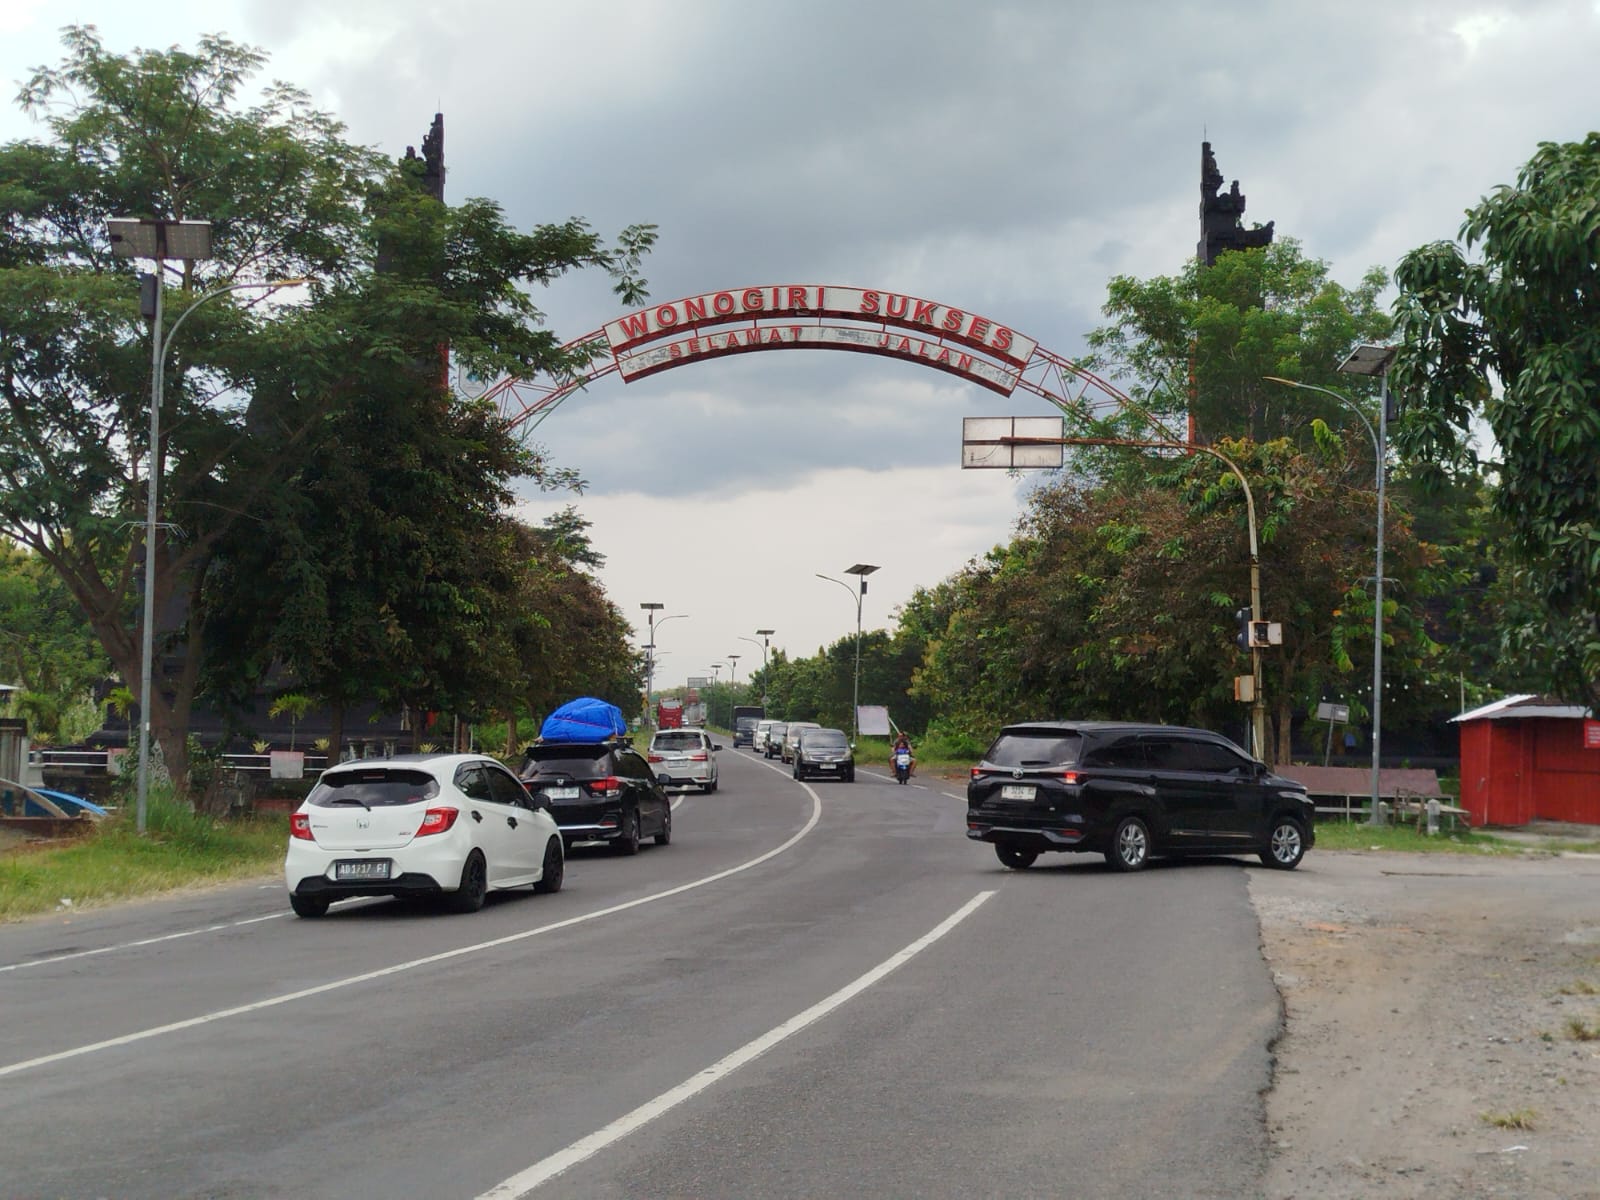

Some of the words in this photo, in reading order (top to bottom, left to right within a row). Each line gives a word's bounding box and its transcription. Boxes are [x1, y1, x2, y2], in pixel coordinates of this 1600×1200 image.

[619, 287, 825, 338] WONOGIRI
[860, 290, 1014, 350] SUKSES
[669, 327, 802, 359] SELAMAT
[878, 333, 973, 370] JALAN
